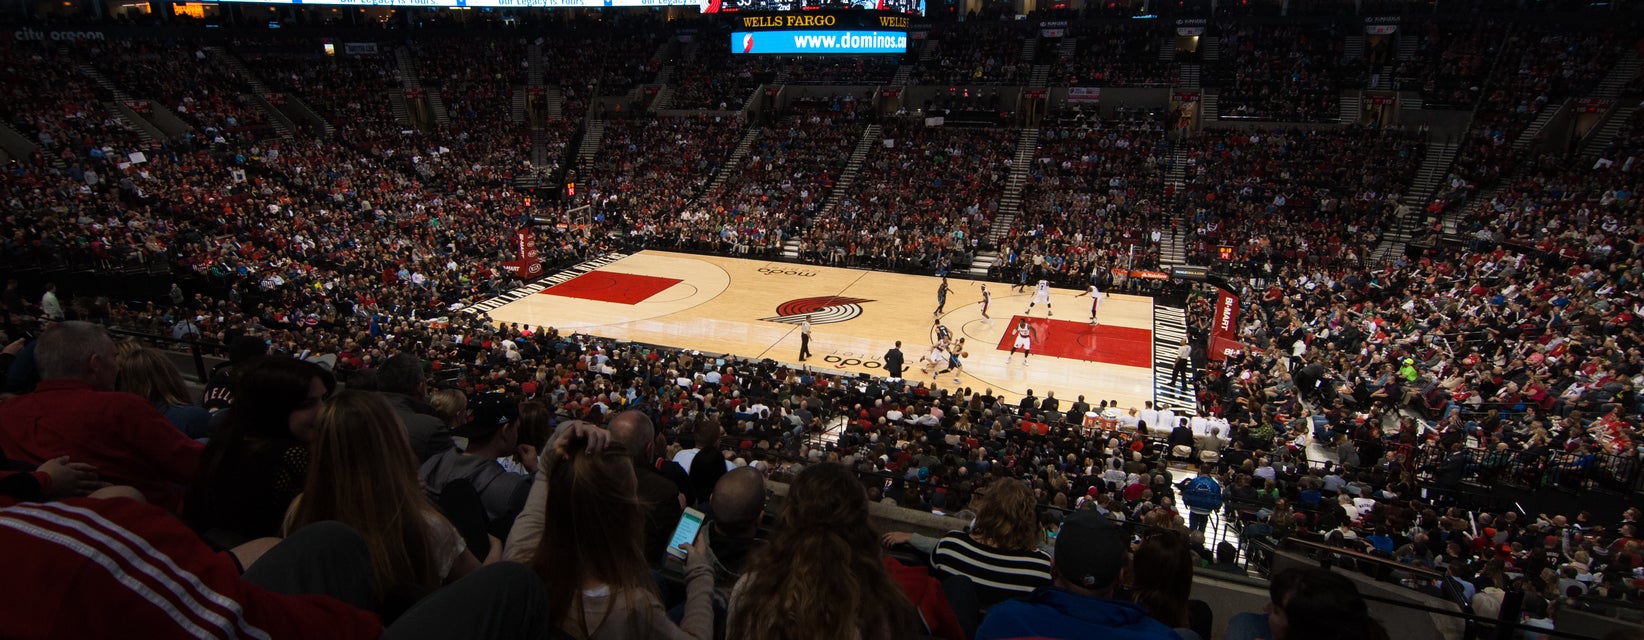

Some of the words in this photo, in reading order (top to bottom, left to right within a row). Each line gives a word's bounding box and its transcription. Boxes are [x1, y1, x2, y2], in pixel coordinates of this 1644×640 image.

[743, 16, 783, 27] WELLS
[786, 15, 836, 27] FARGO
[879, 16, 907, 27] WELLS
[537, 266, 584, 287] TRAIL
[757, 268, 817, 277] moda
[1221, 296, 1233, 332] BI-MART
